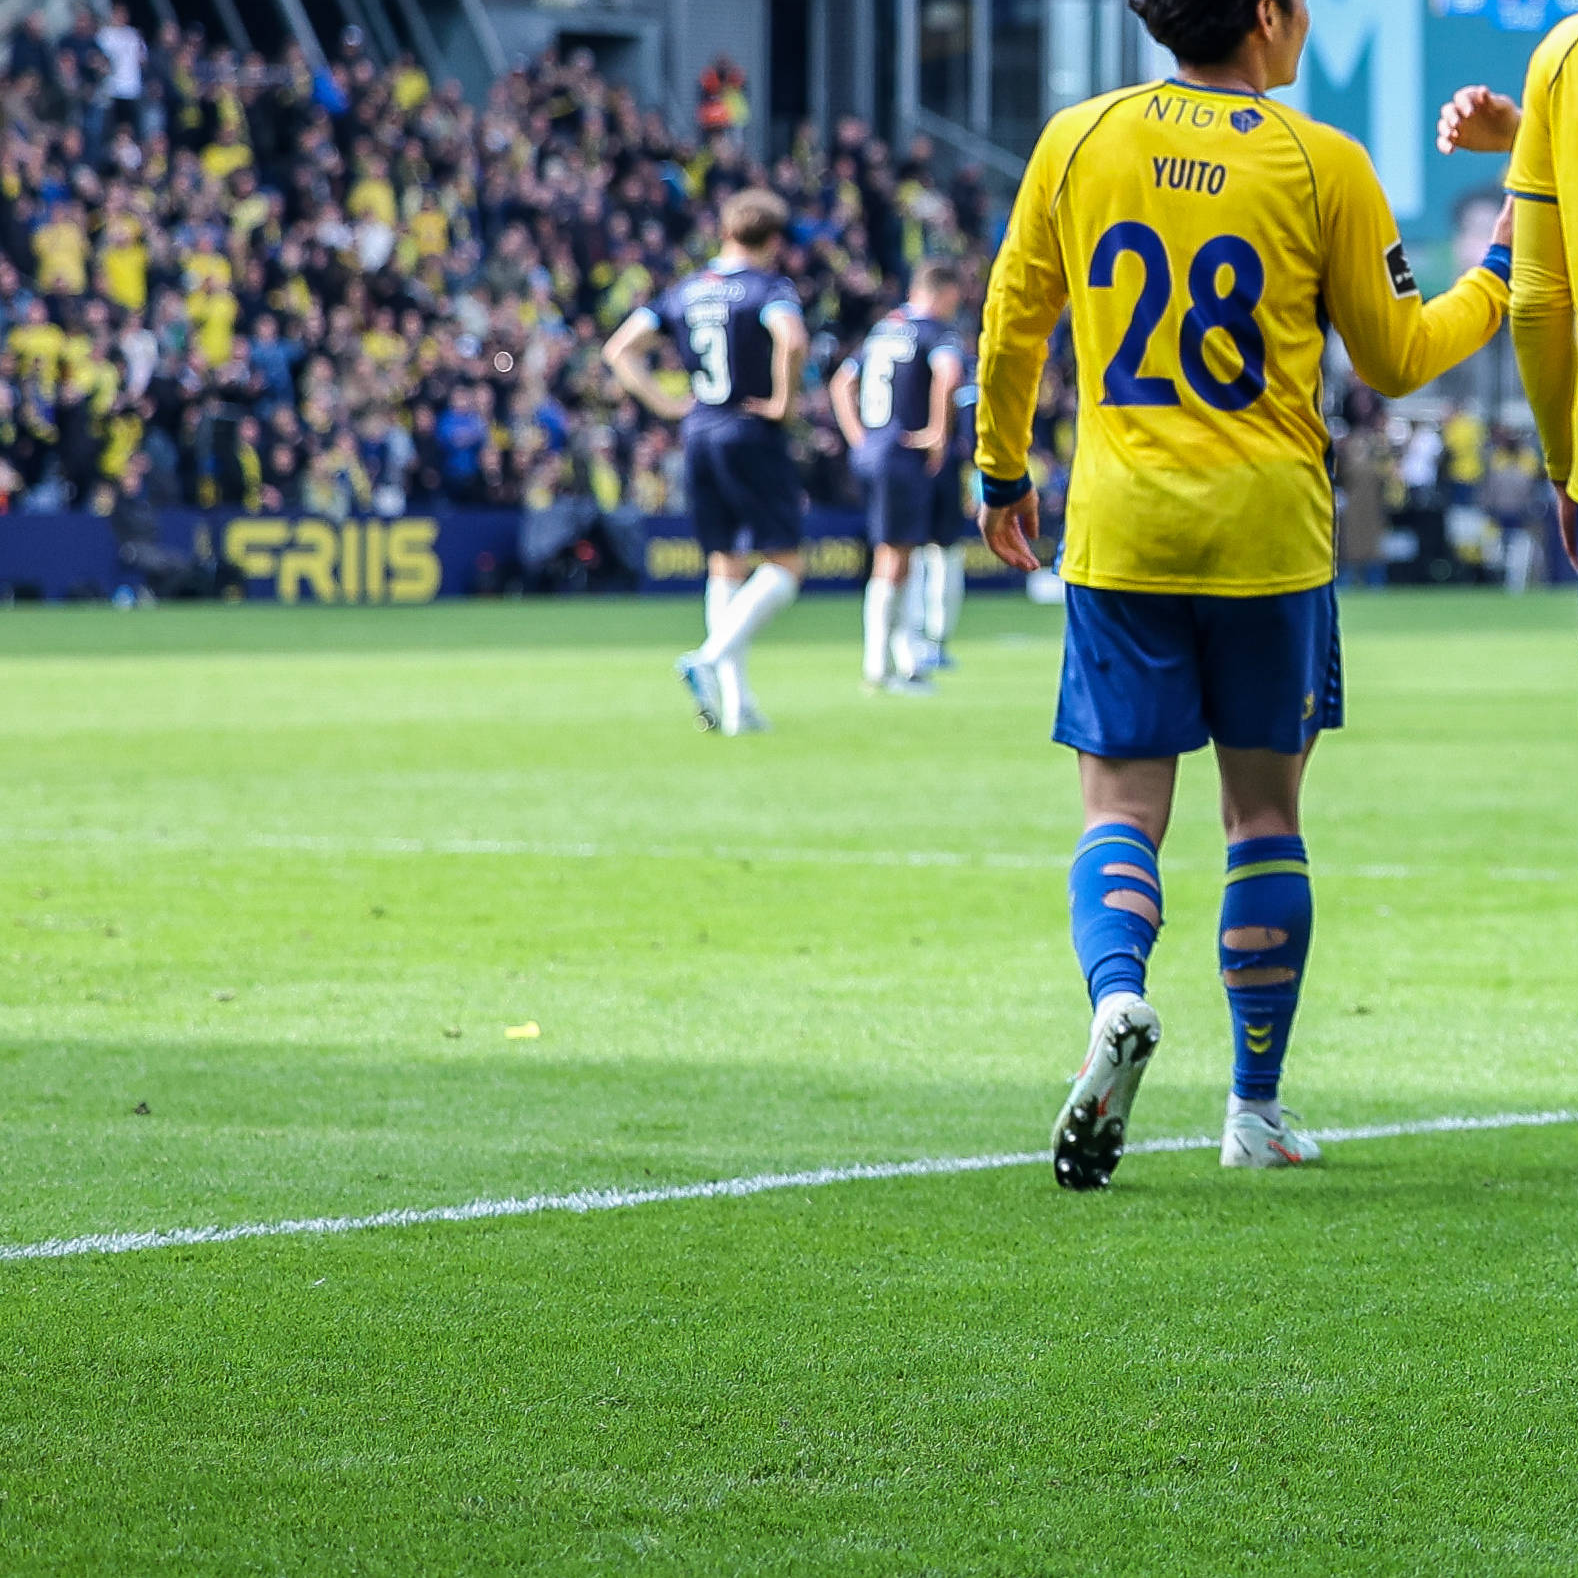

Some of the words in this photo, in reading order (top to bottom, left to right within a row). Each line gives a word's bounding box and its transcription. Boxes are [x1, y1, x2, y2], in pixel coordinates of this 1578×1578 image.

[1144, 94, 1215, 128] NTG
[1152, 155, 1227, 196] YUITO
[1088, 219, 1268, 412] 28
